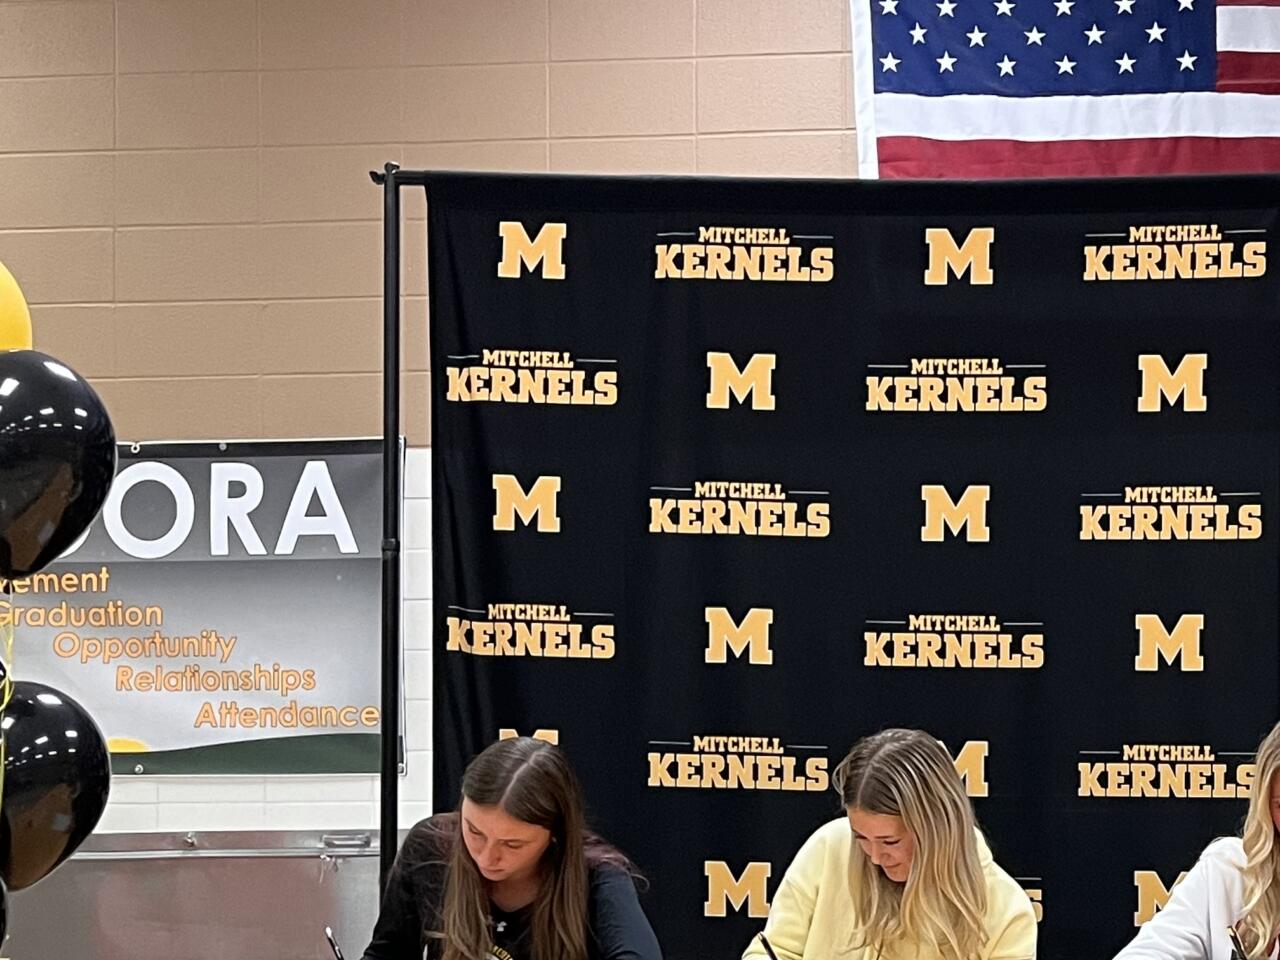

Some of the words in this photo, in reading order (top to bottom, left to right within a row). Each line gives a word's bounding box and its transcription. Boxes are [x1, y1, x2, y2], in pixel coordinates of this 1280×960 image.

[497, 221, 567, 280] M
[699, 226, 789, 245] MITCHELL
[1129, 224, 1222, 243] MITCHELL
[655, 243, 834, 282] KERNELS
[924, 227, 994, 286] M
[1083, 241, 1267, 281] KERNELS
[482, 349, 573, 369] MITCHELL
[911, 358, 1004, 375] MITCHELL
[447, 366, 618, 406] KERNELS
[706, 351, 777, 411] M
[865, 376, 1048, 412] KERNELS
[1137, 353, 1208, 413] M
[492, 474, 561, 533] M
[695, 481, 785, 500] MITCHELL
[1124, 486, 1217, 504] MITCHELL
[58, 460, 361, 560] ORA
[648, 498, 831, 538] KERNELS
[920, 484, 991, 543] M
[1079, 504, 1263, 541] KERNELS
[0, 566, 110, 594] ement
[488, 603, 571, 622] MITCHELL
[909, 614, 1001, 632] MITCHELL
[53, 631, 237, 663] Opportunity
[446, 616, 616, 659] KERNELS
[704, 606, 774, 665] M
[863, 631, 1045, 669] KERNELS
[1135, 613, 1205, 672] M
[115, 664, 316, 696] Relationships
[194, 701, 381, 728] Attendance
[693, 735, 784, 755] MITCHELL
[1122, 744, 1215, 762] MITCHELL
[647, 752, 829, 792] KERNELS
[704, 860, 772, 918] M
